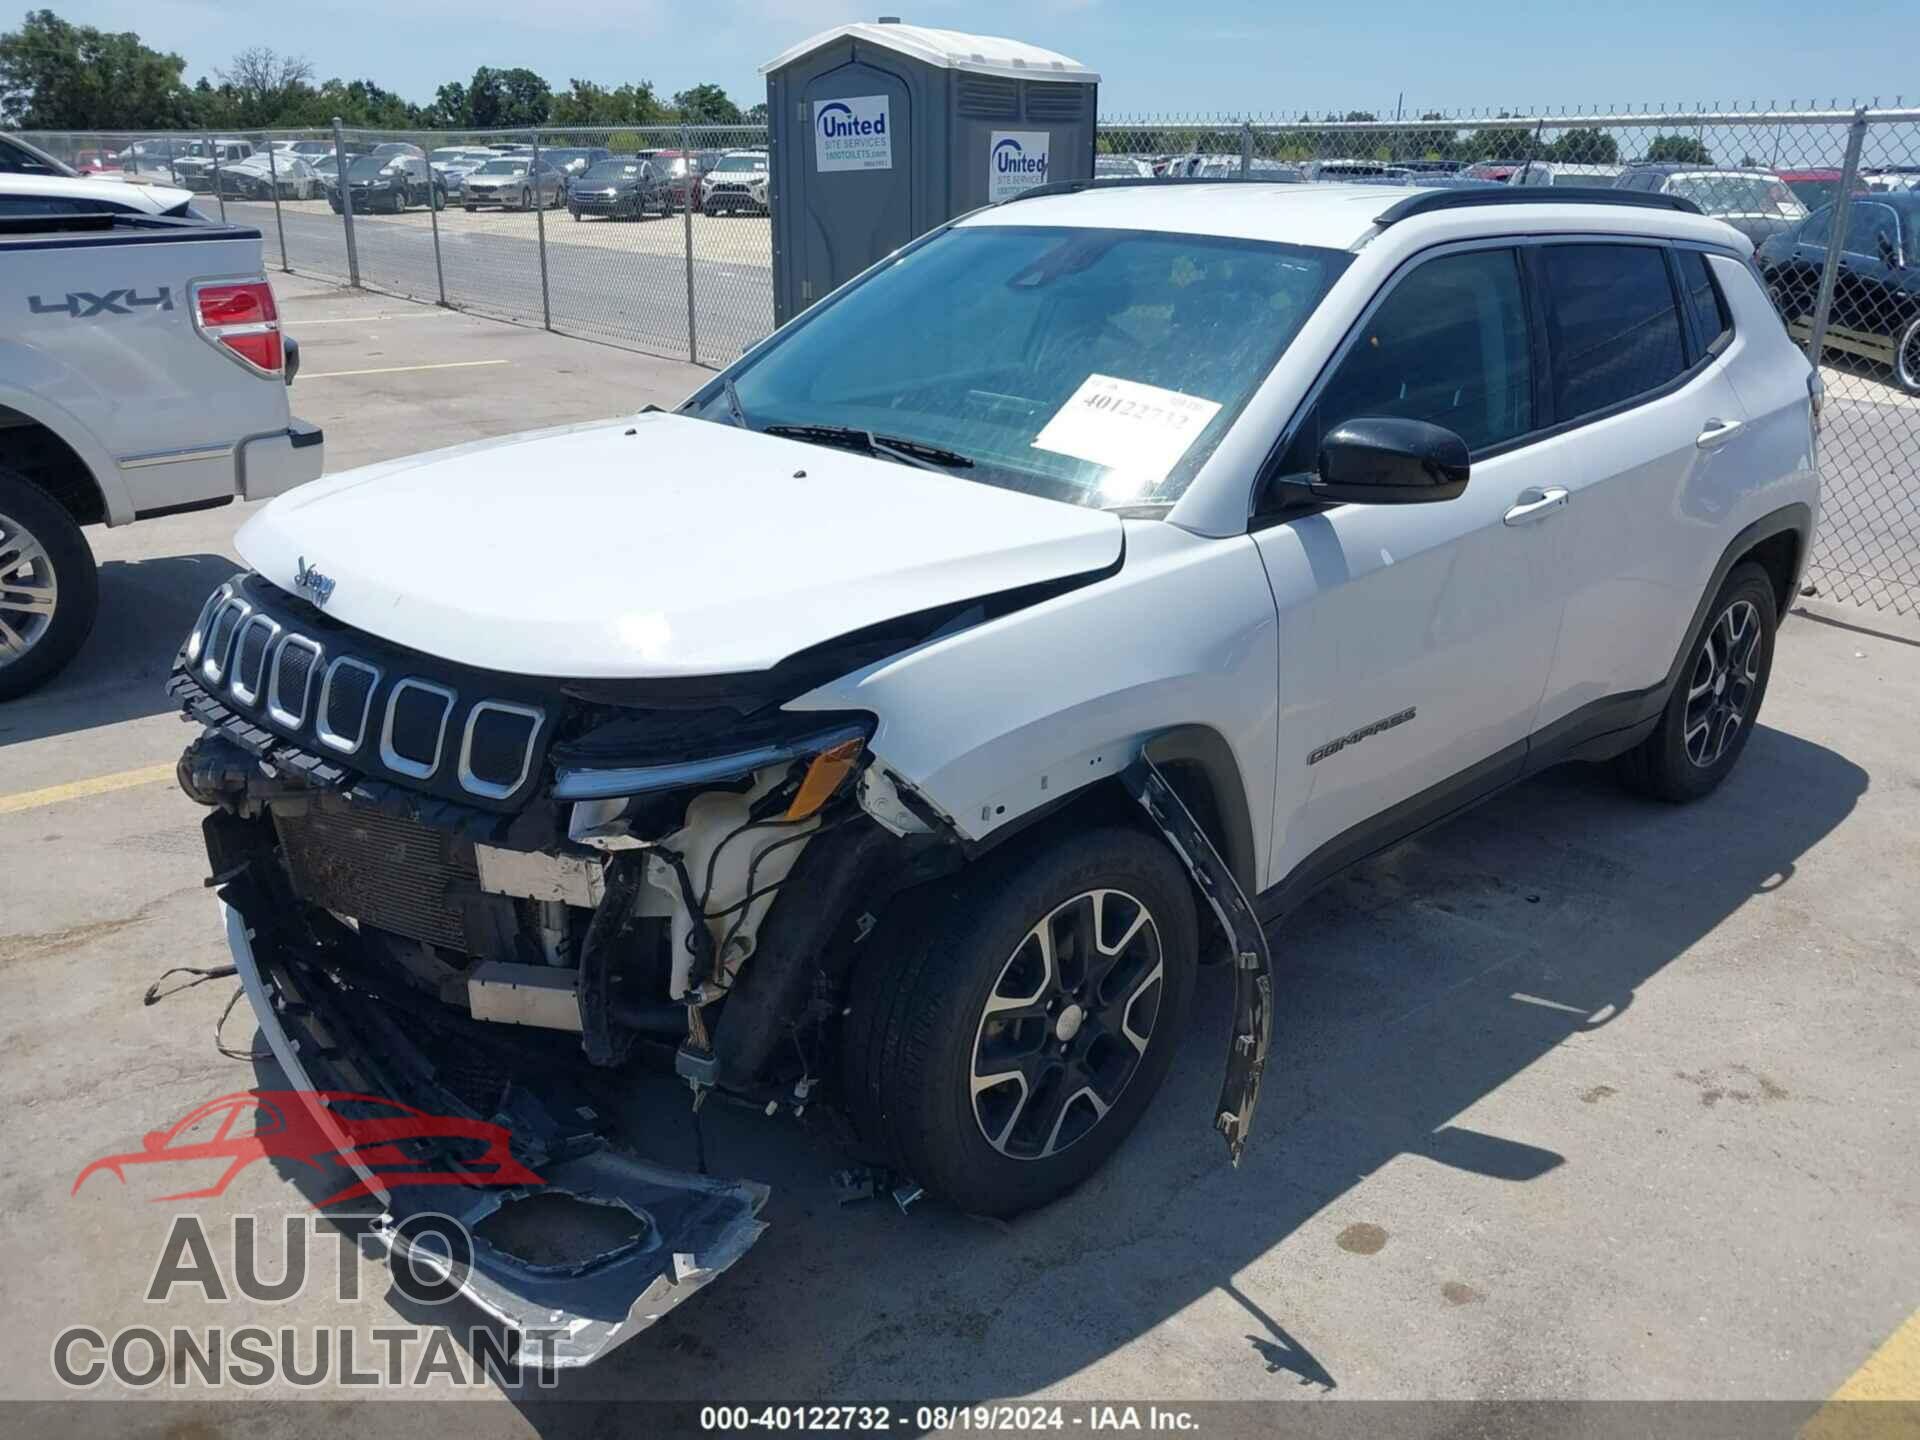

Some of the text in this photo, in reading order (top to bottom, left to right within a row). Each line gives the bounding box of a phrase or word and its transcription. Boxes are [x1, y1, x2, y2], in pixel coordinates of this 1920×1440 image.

[823, 113, 885, 138] United
[825, 137, 887, 150] SITE SERVICES
[997, 152, 1046, 173] United
[1306, 706, 1416, 765] COMPASS
